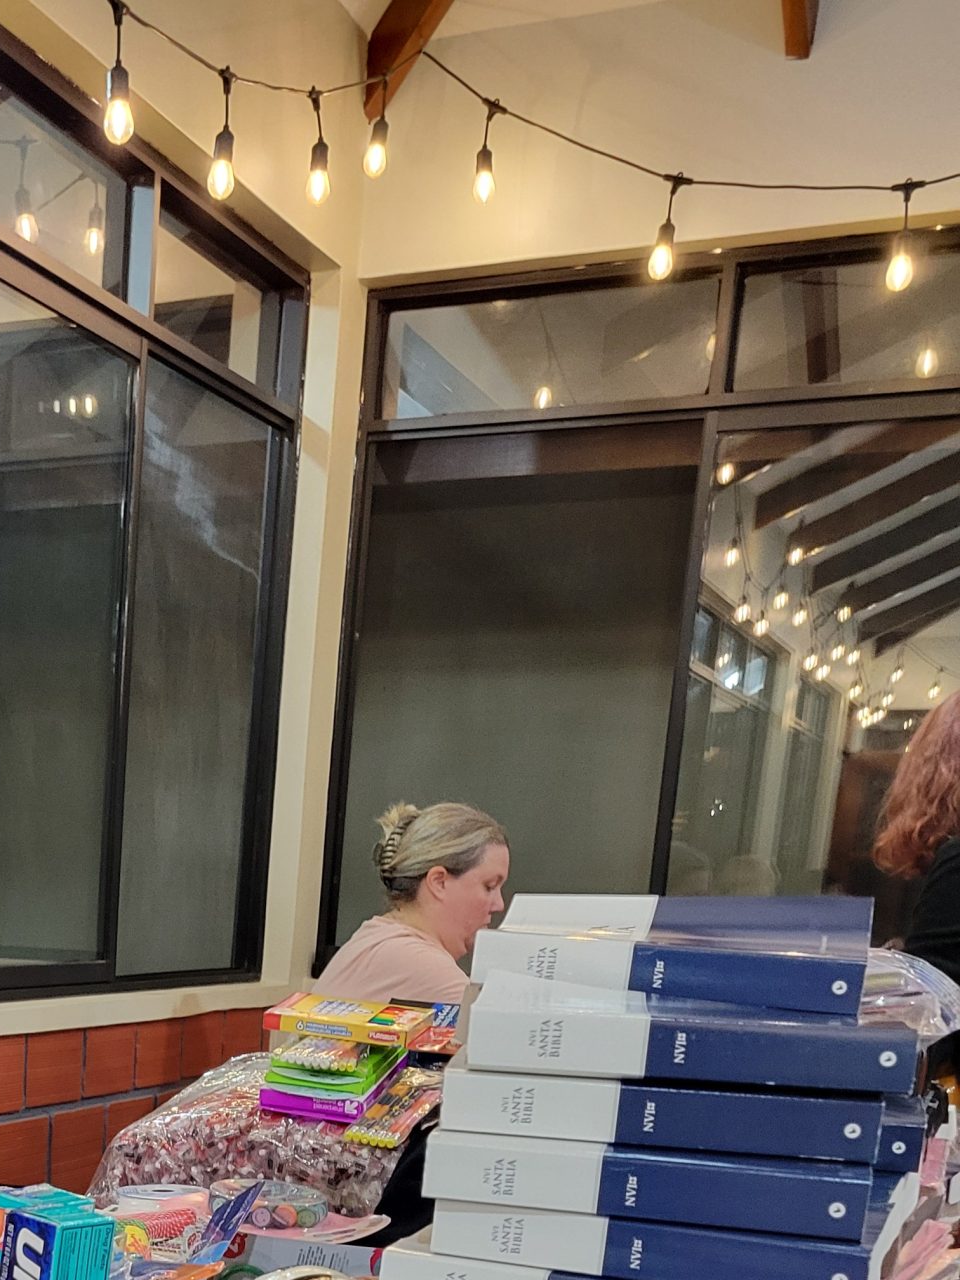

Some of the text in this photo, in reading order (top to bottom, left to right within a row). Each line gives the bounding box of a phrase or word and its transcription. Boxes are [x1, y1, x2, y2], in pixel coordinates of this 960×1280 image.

[545, 948, 558, 980] BIBLIA
[653, 966, 664, 988] NVI
[538, 1020, 551, 1058] SANTA
[549, 1020, 563, 1058] BIBLIA
[674, 1038, 686, 1064] NVI
[510, 1087, 522, 1124] SANTA
[521, 1088, 535, 1124] BIBLIA
[643, 1107, 654, 1132] NVI
[492, 1159, 504, 1195] SANTA
[503, 1160, 517, 1196] BIBLIA
[625, 1182, 637, 1207] NVI
[500, 1217, 512, 1254] SANTA
[511, 1218, 524, 1254] BIBLIA
[630, 1245, 642, 1270] NVI
